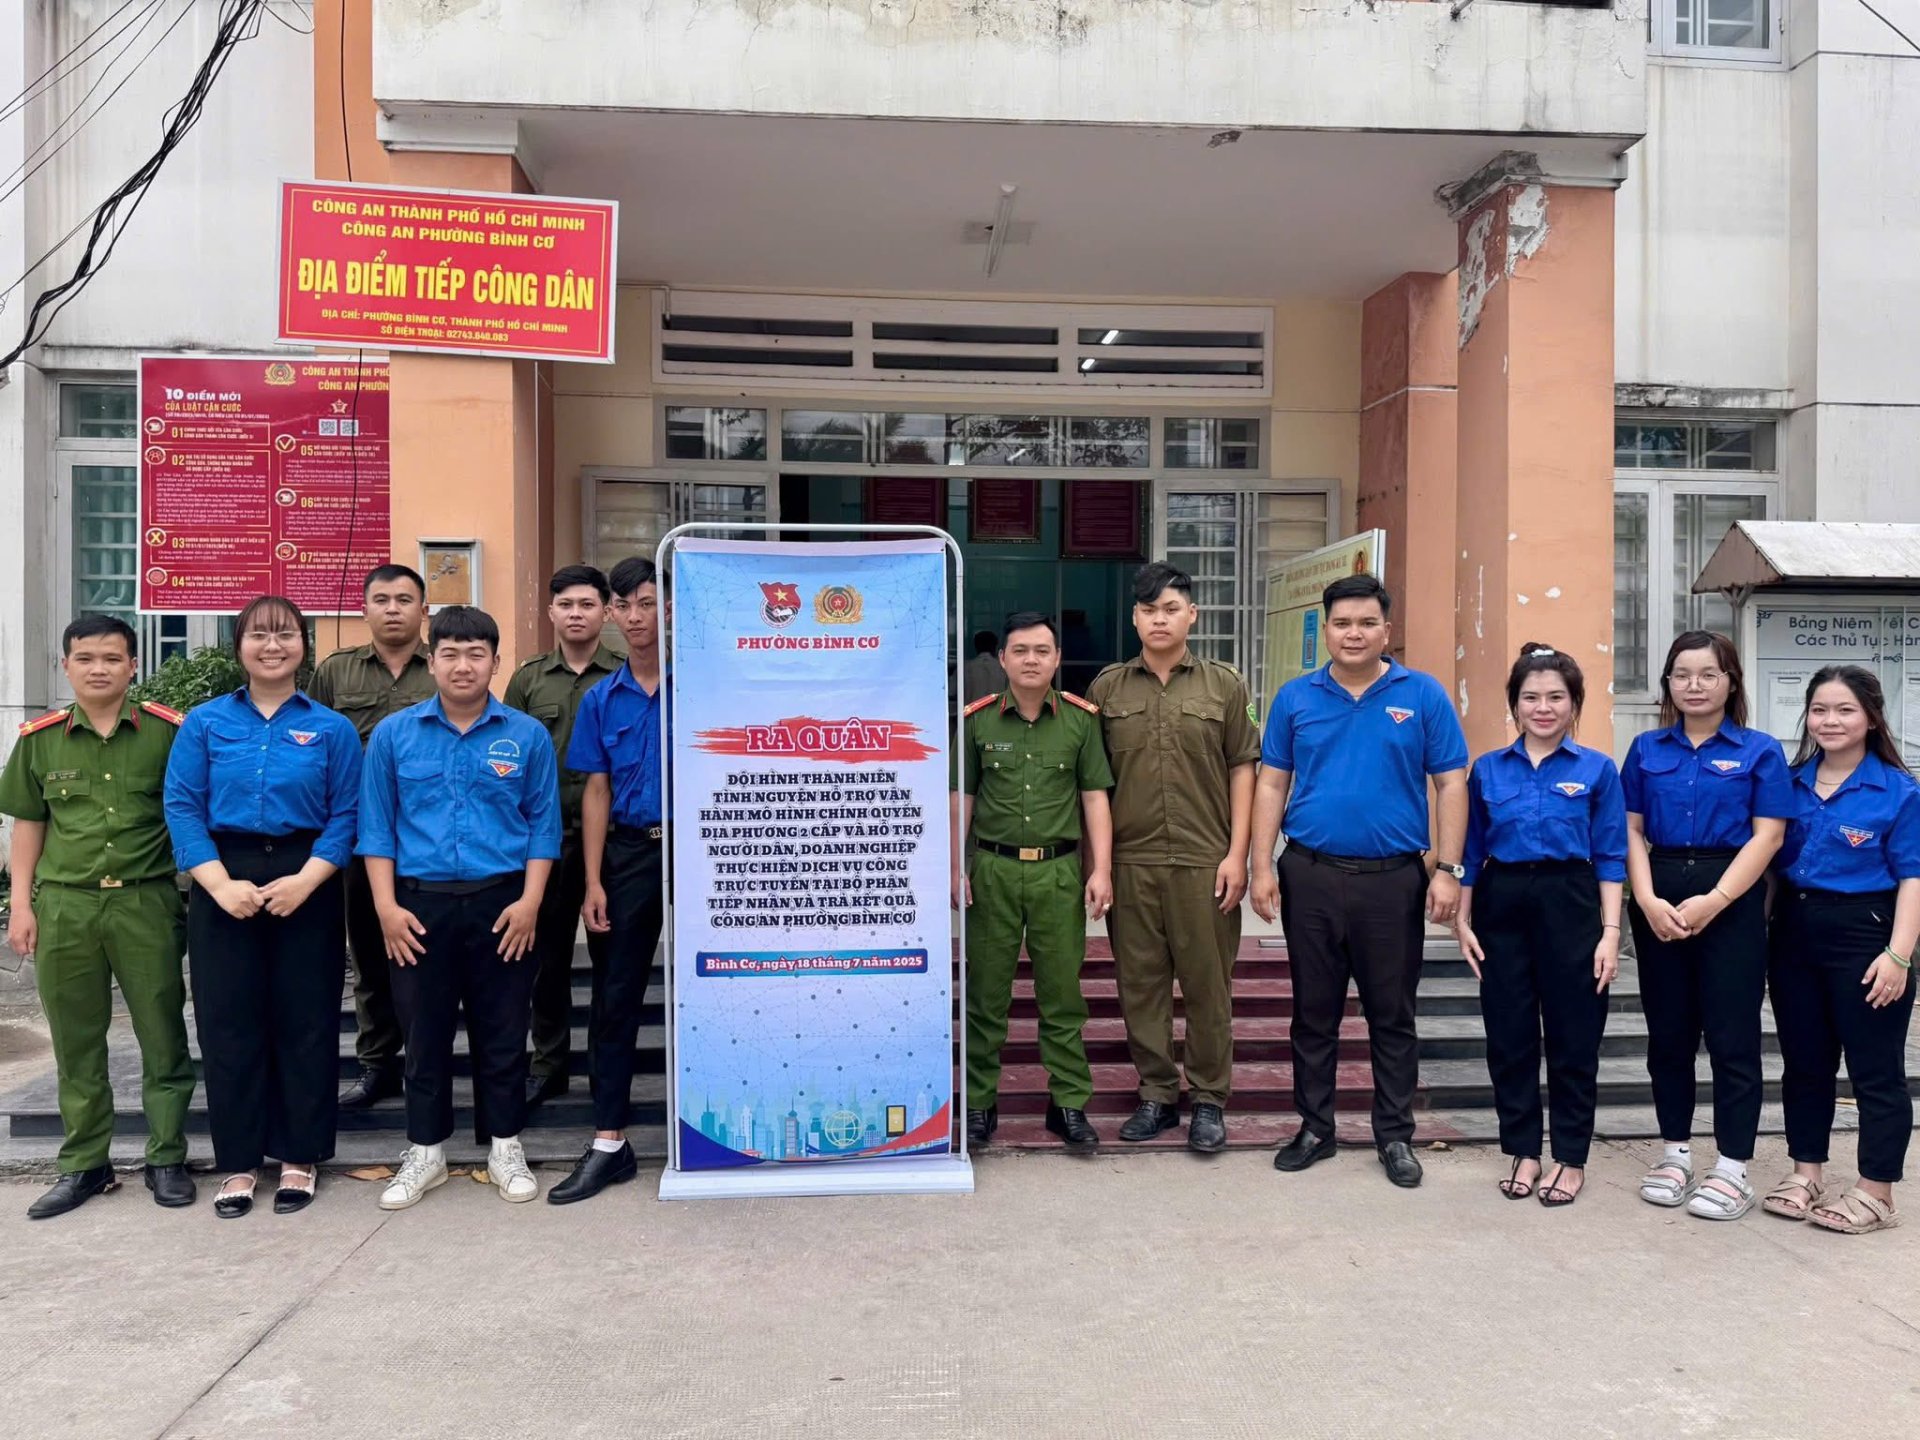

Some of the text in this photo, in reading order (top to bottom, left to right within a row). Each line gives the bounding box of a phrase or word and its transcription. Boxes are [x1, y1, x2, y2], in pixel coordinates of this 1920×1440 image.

[312, 199, 357, 214] CÔNG
[362, 204, 385, 216] AN
[390, 204, 443, 221] THÀNH
[447, 207, 480, 223] PHỐ
[511, 213, 538, 228] CHÍ
[542, 216, 585, 231] MINH
[342, 220, 555, 249] CÔNG AN PHƯỜNG BÌNH CƠ
[298, 249, 594, 311] ĐỊA ĐIỂM TIẾP CÔNG DÂN
[322, 309, 338, 320] ĐỊA
[363, 311, 403, 322] PHƯỜNG
[406, 313, 429, 324] BÌNH
[451, 316, 482, 327] THÀNH
[485, 318, 505, 329] PHỐ
[523, 321, 540, 331] CHÍ
[542, 322, 568, 333] MINH
[381, 324, 393, 334] SỐ
[394, 325, 415, 336] ĐIỆN
[302, 365, 326, 376] CÔNG
[328, 367, 341, 376] AN
[318, 380, 342, 391] CÔNG
[344, 382, 357, 390] AN
[165, 388, 184, 400] 10
[172, 427, 184, 438] 01
[301, 445, 314, 456] 05
[172, 454, 185, 466] 02
[301, 497, 314, 508] 06
[172, 537, 185, 549] 03
[300, 552, 313, 563] 07
[172, 576, 185, 587] 04
[1789, 615, 1828, 631] Bảng
[1833, 616, 1873, 629] Niêm
[737, 634, 880, 649] PHƯỜNG BÌNH CƠ
[1795, 634, 1827, 646] Các
[1832, 632, 1857, 646] Thủ
[1862, 634, 1889, 649] Tục
[746, 717, 891, 752] RA QUÂN
[728, 771, 756, 787] ĐỘI
[758, 769, 799, 785] HÌNH
[859, 769, 896, 783] NIÊN
[713, 785, 911, 804] TÌNH NGUYỆN HỖ TRỢ VẬN
[700, 806, 744, 821] HÀNH
[748, 806, 772, 820] MÔ
[776, 806, 815, 819] HÌNH
[819, 805, 868, 819] CHÍNH
[701, 819, 923, 841] ĐỊA PHƯƠNG 2 CẤP VÀ HỖ TRỢ
[709, 842, 758, 856] NGƯỜI
[761, 842, 799, 858] DÂN,
[859, 839, 917, 856] NGHIỆP
[716, 857, 907, 876] THỰC HIỆN DỊCH VỤ CÔNG
[714, 874, 909, 894] TRỰC TUYẾN TẠI BỘ PHẬN
[708, 891, 916, 910] TIẾP NHẬN VÀ TRẢ KẾT QUẢ
[759, 914, 780, 926] AN
[783, 909, 849, 927] PHƯỜNG
[852, 908, 890, 925] BÌNH
[706, 956, 923, 971] Bình Cơ, ngày 18 tháng 7 năm 2025
